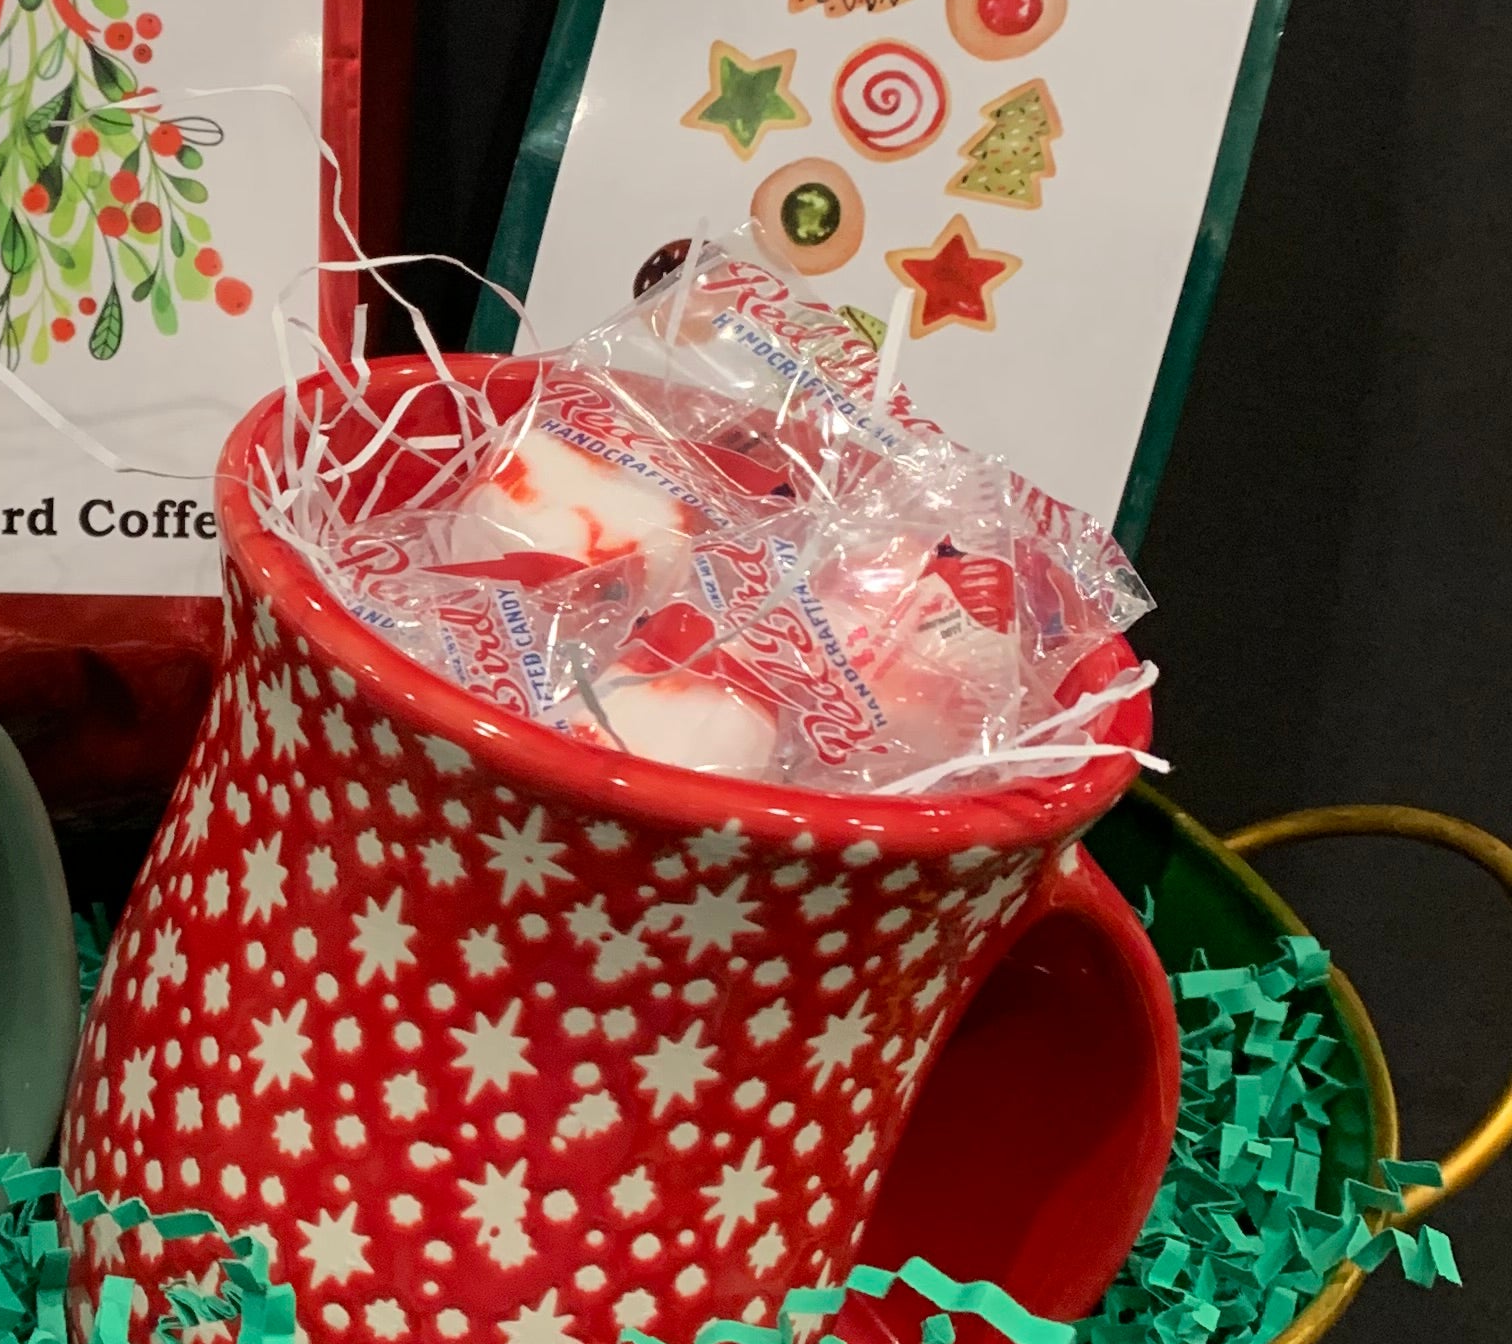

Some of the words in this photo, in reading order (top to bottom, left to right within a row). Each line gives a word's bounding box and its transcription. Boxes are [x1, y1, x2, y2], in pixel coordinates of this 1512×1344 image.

[701, 262, 850, 355] Red
[712, 313, 856, 416] HANDCRAFTED
[541, 419, 700, 505] HANDCRAFTED
[79, 498, 218, 541] Coffe
[439, 594, 530, 717] Bird
[495, 587, 534, 648] CANDY
[754, 657, 890, 765] Red
